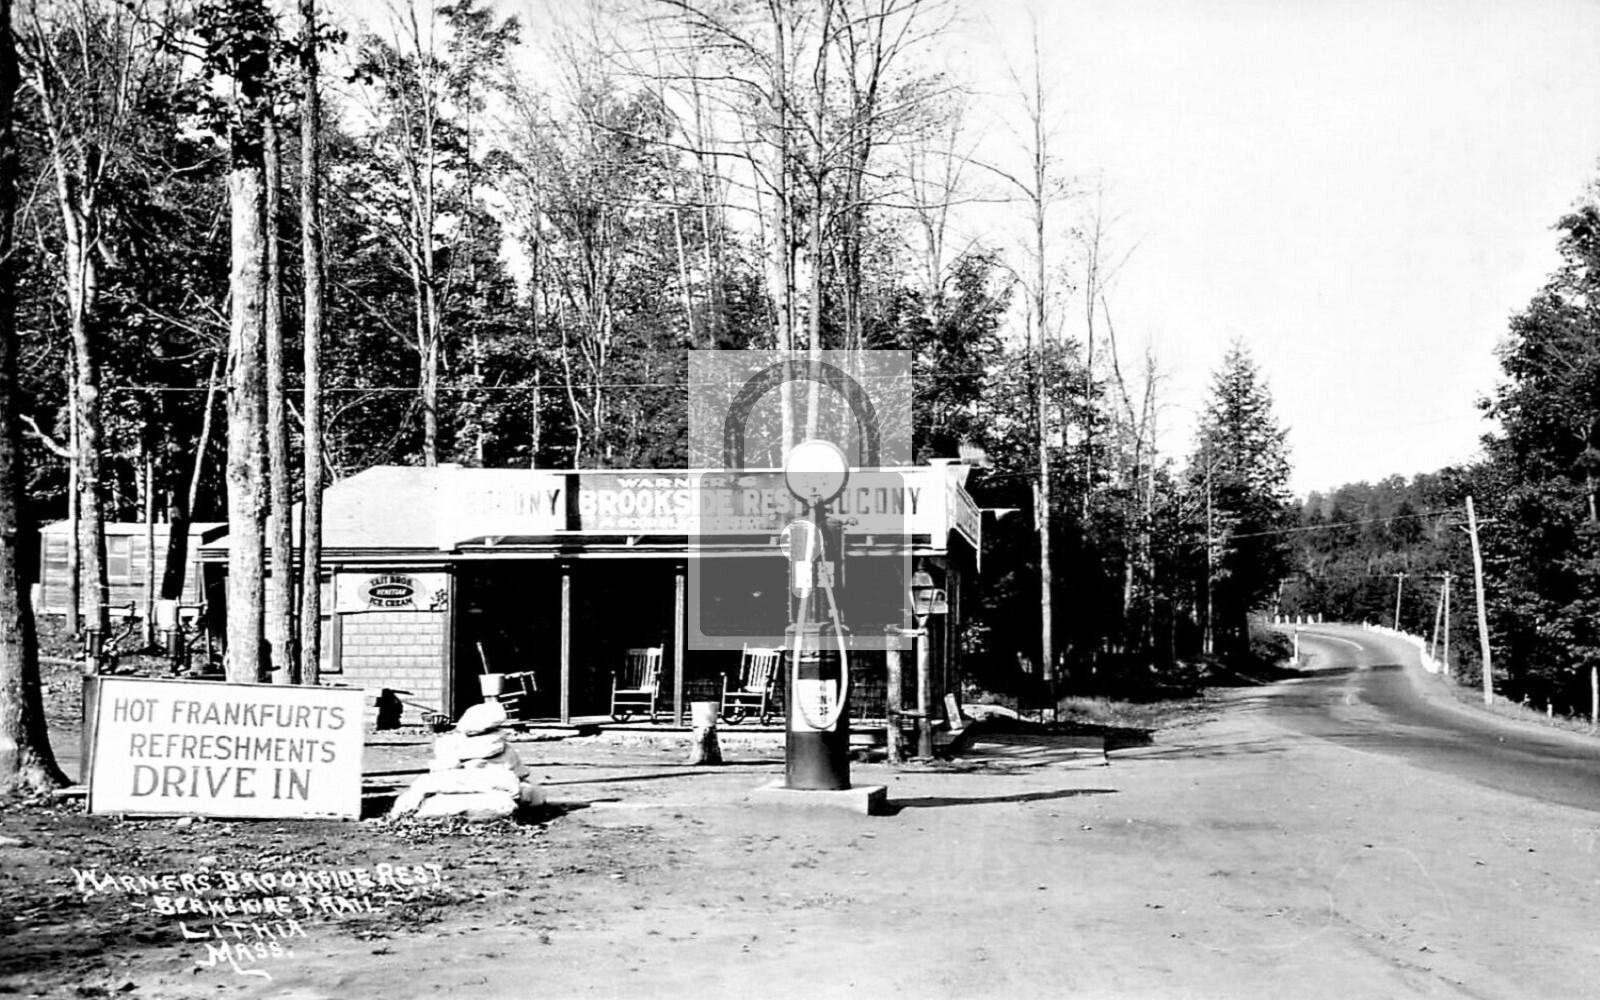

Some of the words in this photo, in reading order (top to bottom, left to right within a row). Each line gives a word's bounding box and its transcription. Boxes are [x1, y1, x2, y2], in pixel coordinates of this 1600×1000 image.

[580, 489, 734, 515] BROOKSIDE
[369, 597, 383, 606] ICE
[385, 597, 413, 607] CREAM
[113, 697, 158, 723] HOT
[172, 700, 346, 730] FRANKFURTS
[129, 733, 336, 763] REFRESHMENTS
[131, 764, 257, 798] DRIVE
[273, 768, 311, 800] IN
